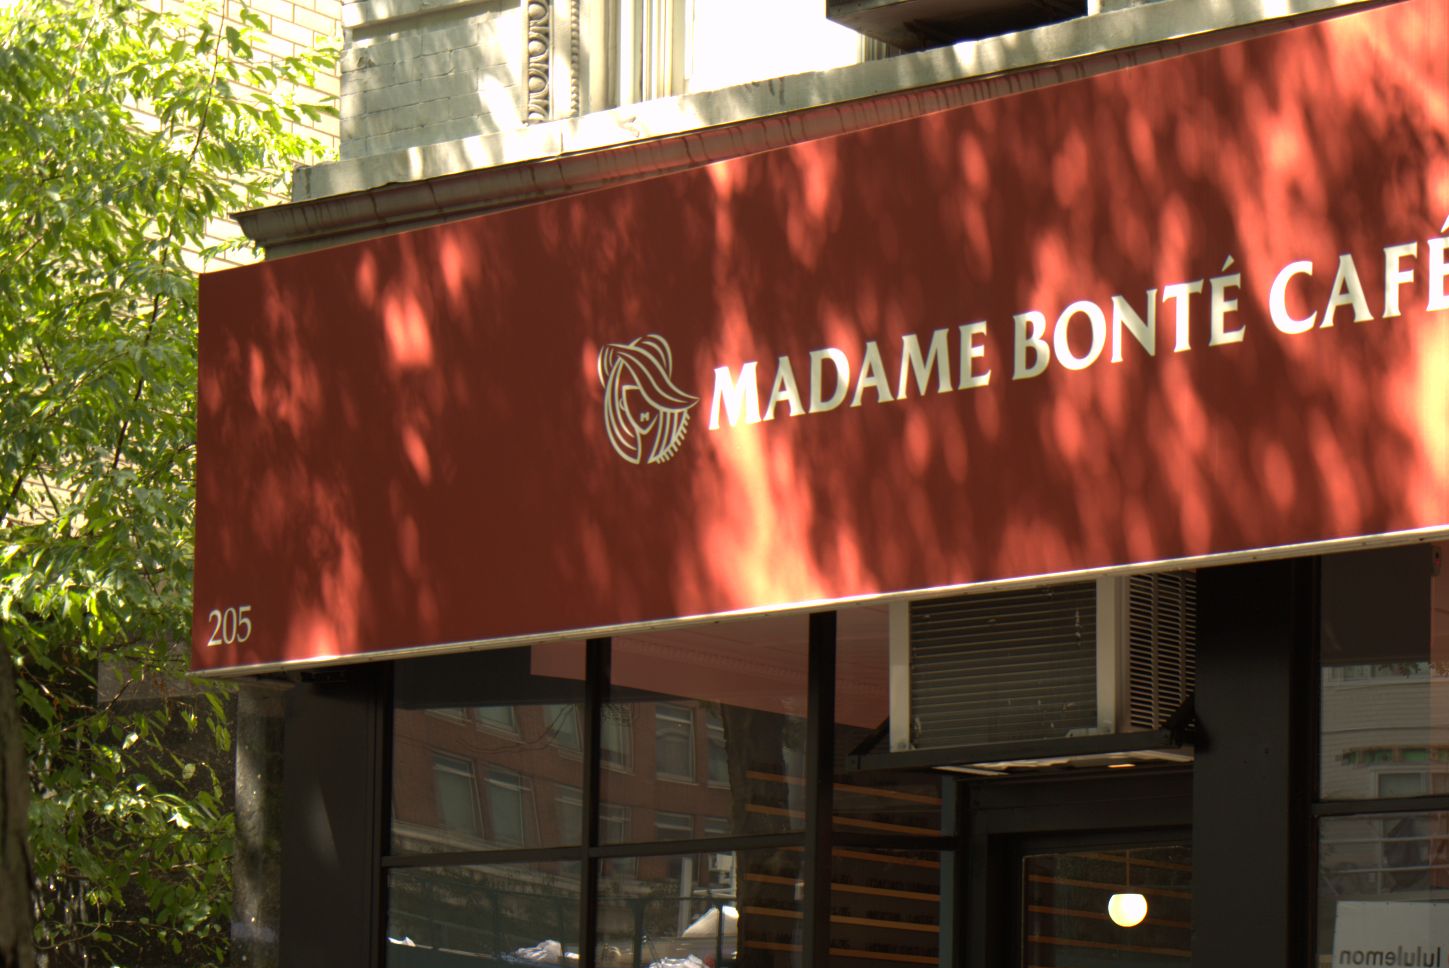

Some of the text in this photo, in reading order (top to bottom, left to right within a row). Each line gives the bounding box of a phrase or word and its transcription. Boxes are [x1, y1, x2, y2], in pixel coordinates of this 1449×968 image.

[708, 320, 992, 431] MADAME
[1012, 254, 1246, 382] BONTÉ
[207, 605, 253, 647] 205
